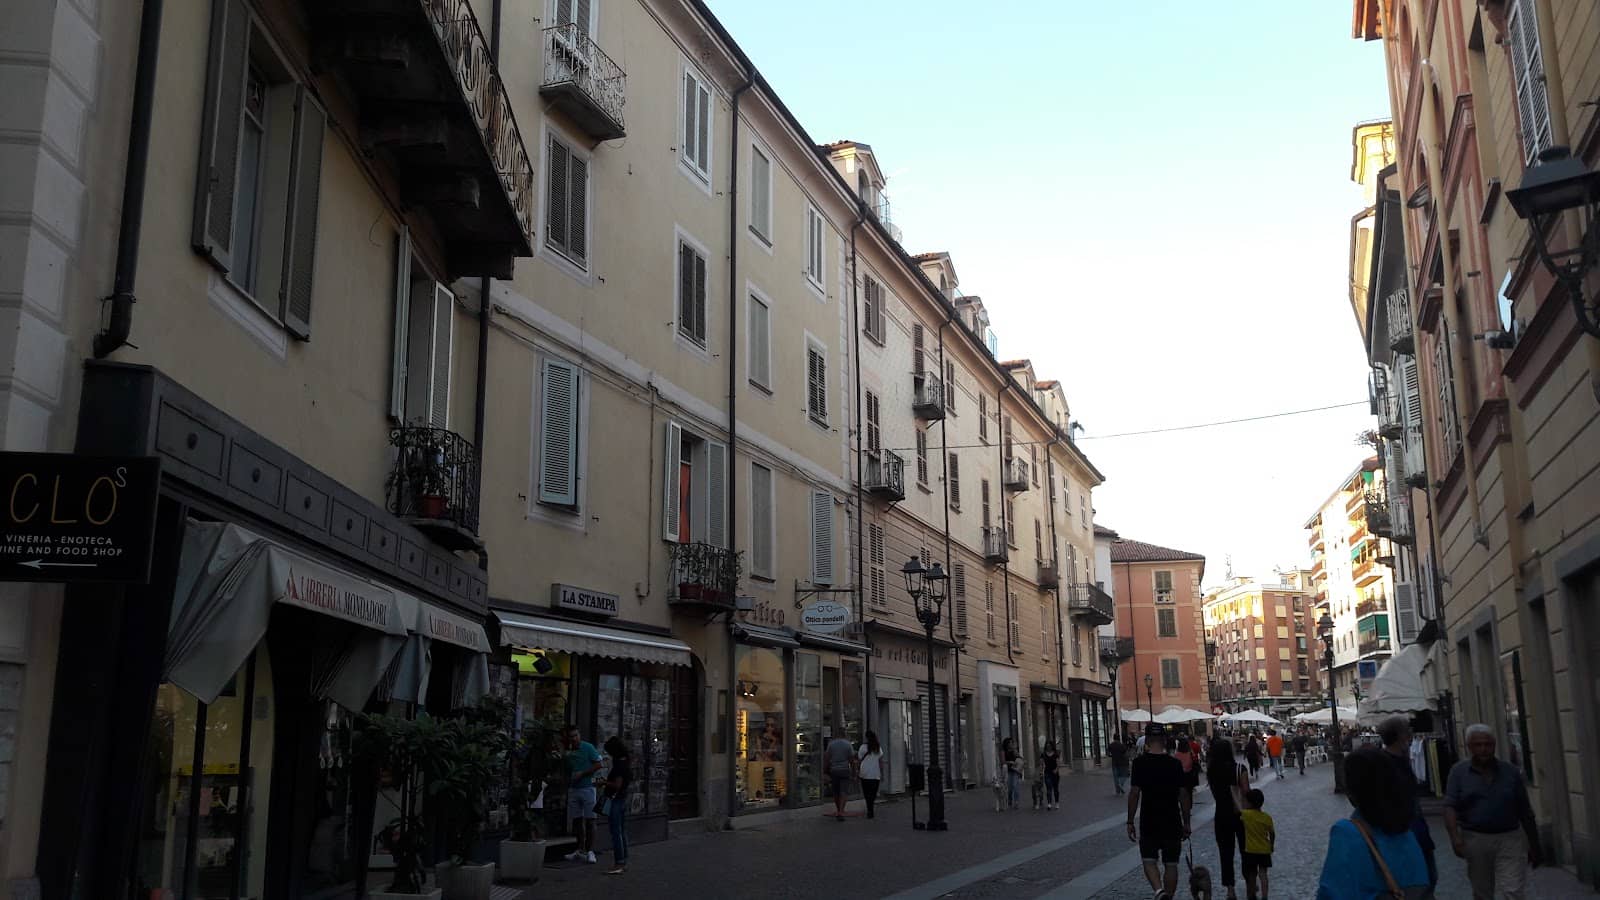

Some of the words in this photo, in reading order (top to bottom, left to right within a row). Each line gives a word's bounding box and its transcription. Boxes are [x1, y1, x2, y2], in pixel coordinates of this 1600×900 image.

[5, 534, 52, 544] VINERIA
[60, 535, 113, 546] ENOTECA
[26, 545, 52, 555] AND
[55, 547, 89, 556] FOOD
[92, 547, 123, 557] SHOP
[301, 575, 342, 613] LIBRERIA
[343, 591, 388, 626] MONDADORI
[562, 590, 577, 605] LA
[577, 593, 617, 612] STAMPA
